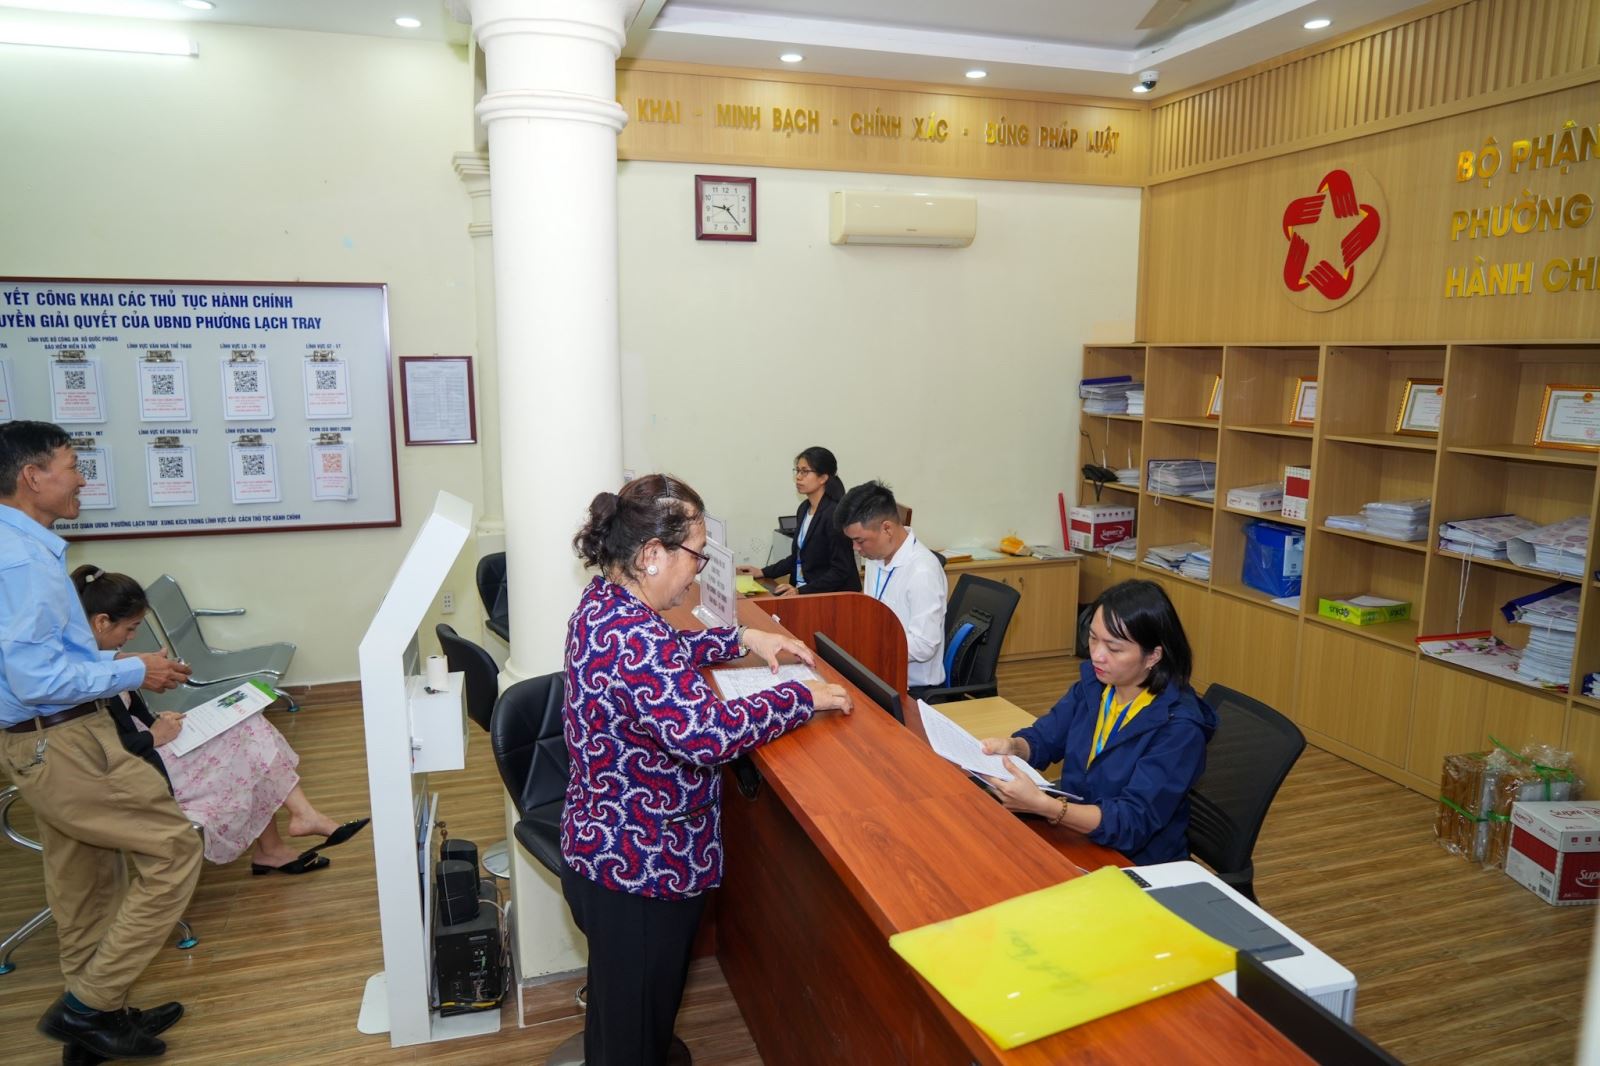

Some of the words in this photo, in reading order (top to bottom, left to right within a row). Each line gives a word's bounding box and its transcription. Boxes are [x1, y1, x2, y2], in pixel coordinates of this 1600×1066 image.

[637, 98, 681, 124] KHAI
[716, 103, 761, 130] MINH
[772, 107, 820, 138] BẠCH
[851, 106, 902, 138] CHÍNH
[911, 111, 949, 143] XÁC
[984, 116, 1029, 145] ĐÚNG
[1039, 121, 1079, 151] PHÁP
[1085, 125, 1120, 158] LUẬT
[1456, 135, 1503, 189] BỘ
[1509, 119, 1600, 175] PHẬN
[1451, 187, 1595, 241] PHƯỜNG
[3, 286, 30, 306] YẾT
[36, 289, 76, 306] CÔNG
[80, 292, 114, 307] KHAI
[118, 290, 146, 307] CÁC
[150, 289, 176, 308] THỦ
[182, 294, 208, 310] TỤC
[212, 292, 249, 308] HÀNH
[252, 293, 293, 309] CHÍNH
[1445, 255, 1535, 299] HÀNH
[40, 311, 70, 329] GIẢI
[74, 310, 118, 330] QUYẾT
[122, 310, 150, 329] CỦA
[154, 315, 192, 329] UBND
[196, 311, 250, 329] PHƯỜNG
[255, 316, 288, 332] LẠCH
[292, 317, 322, 330] TRAY
